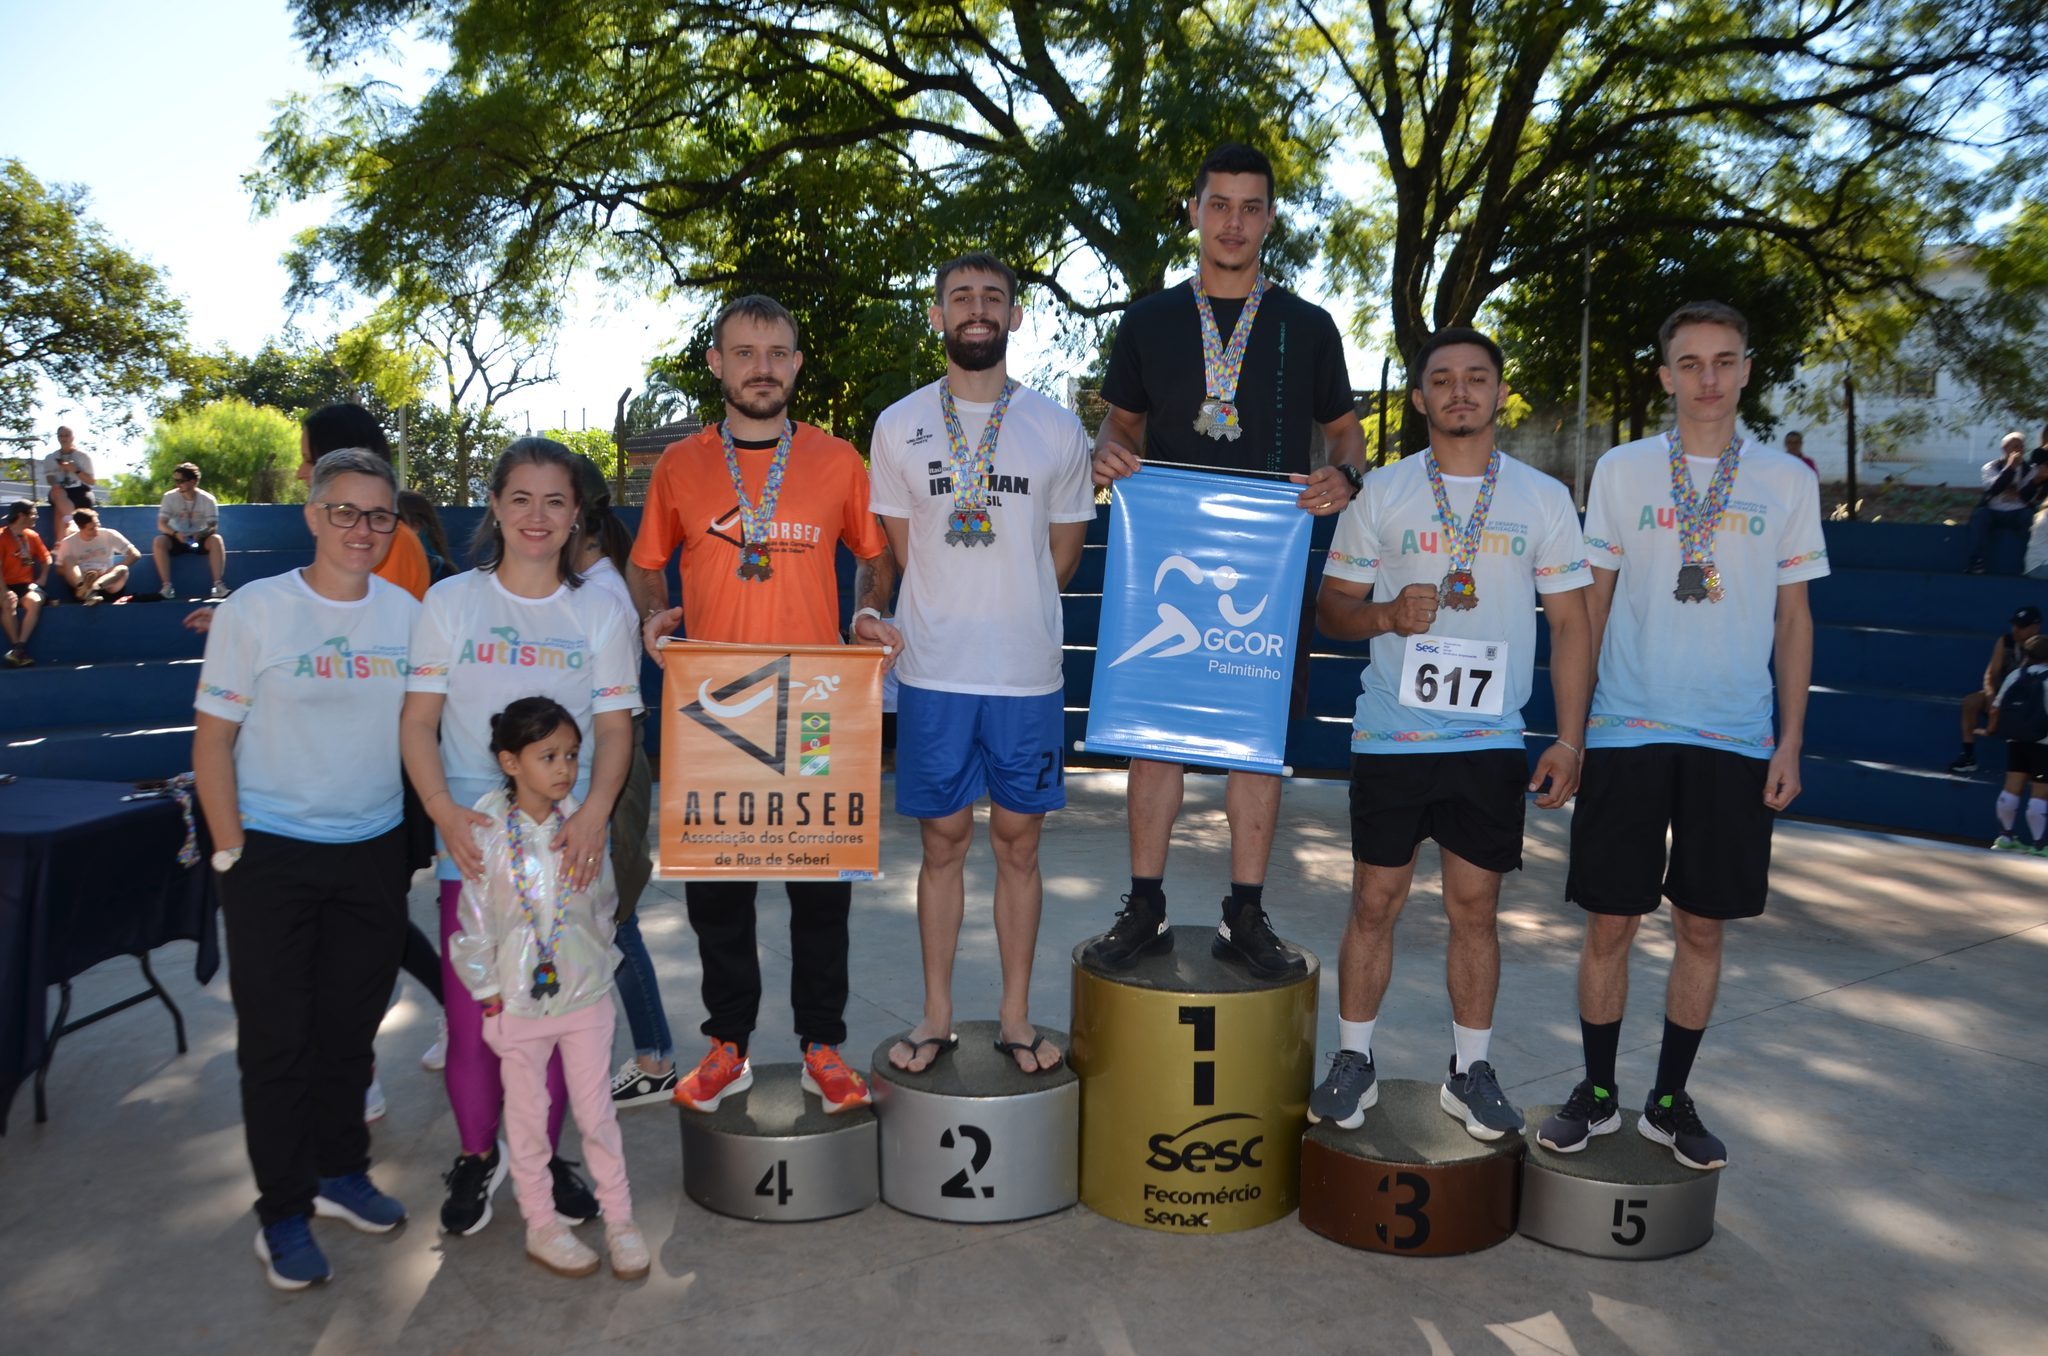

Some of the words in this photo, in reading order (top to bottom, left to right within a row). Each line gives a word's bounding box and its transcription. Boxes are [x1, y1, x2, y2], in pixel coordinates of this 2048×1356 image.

[1638, 504, 1766, 536] Aumo
[459, 638, 583, 670] Autismo
[1203, 627, 1284, 657] GCOR
[1208, 659, 1281, 681] Palmitinho
[1415, 663, 1493, 708] 617
[683, 790, 865, 827] ACORSEB
[680, 831, 755, 848] Associação
[759, 831, 784, 844] dos
[788, 831, 864, 845] Corredores
[714, 853, 731, 866] de
[737, 853, 762, 866] Rua
[766, 853, 783, 866] de
[787, 852, 830, 866] Seberi
[1178, 1005, 1216, 1106] 1
[939, 1124, 995, 1199] 2
[754, 1160, 793, 1206] 4
[1143, 1183, 1262, 1205] Fecomércio
[1143, 1207, 1209, 1228] Senac
[1375, 1171, 1431, 1250] 3
[1610, 1198, 1648, 1247] 5
